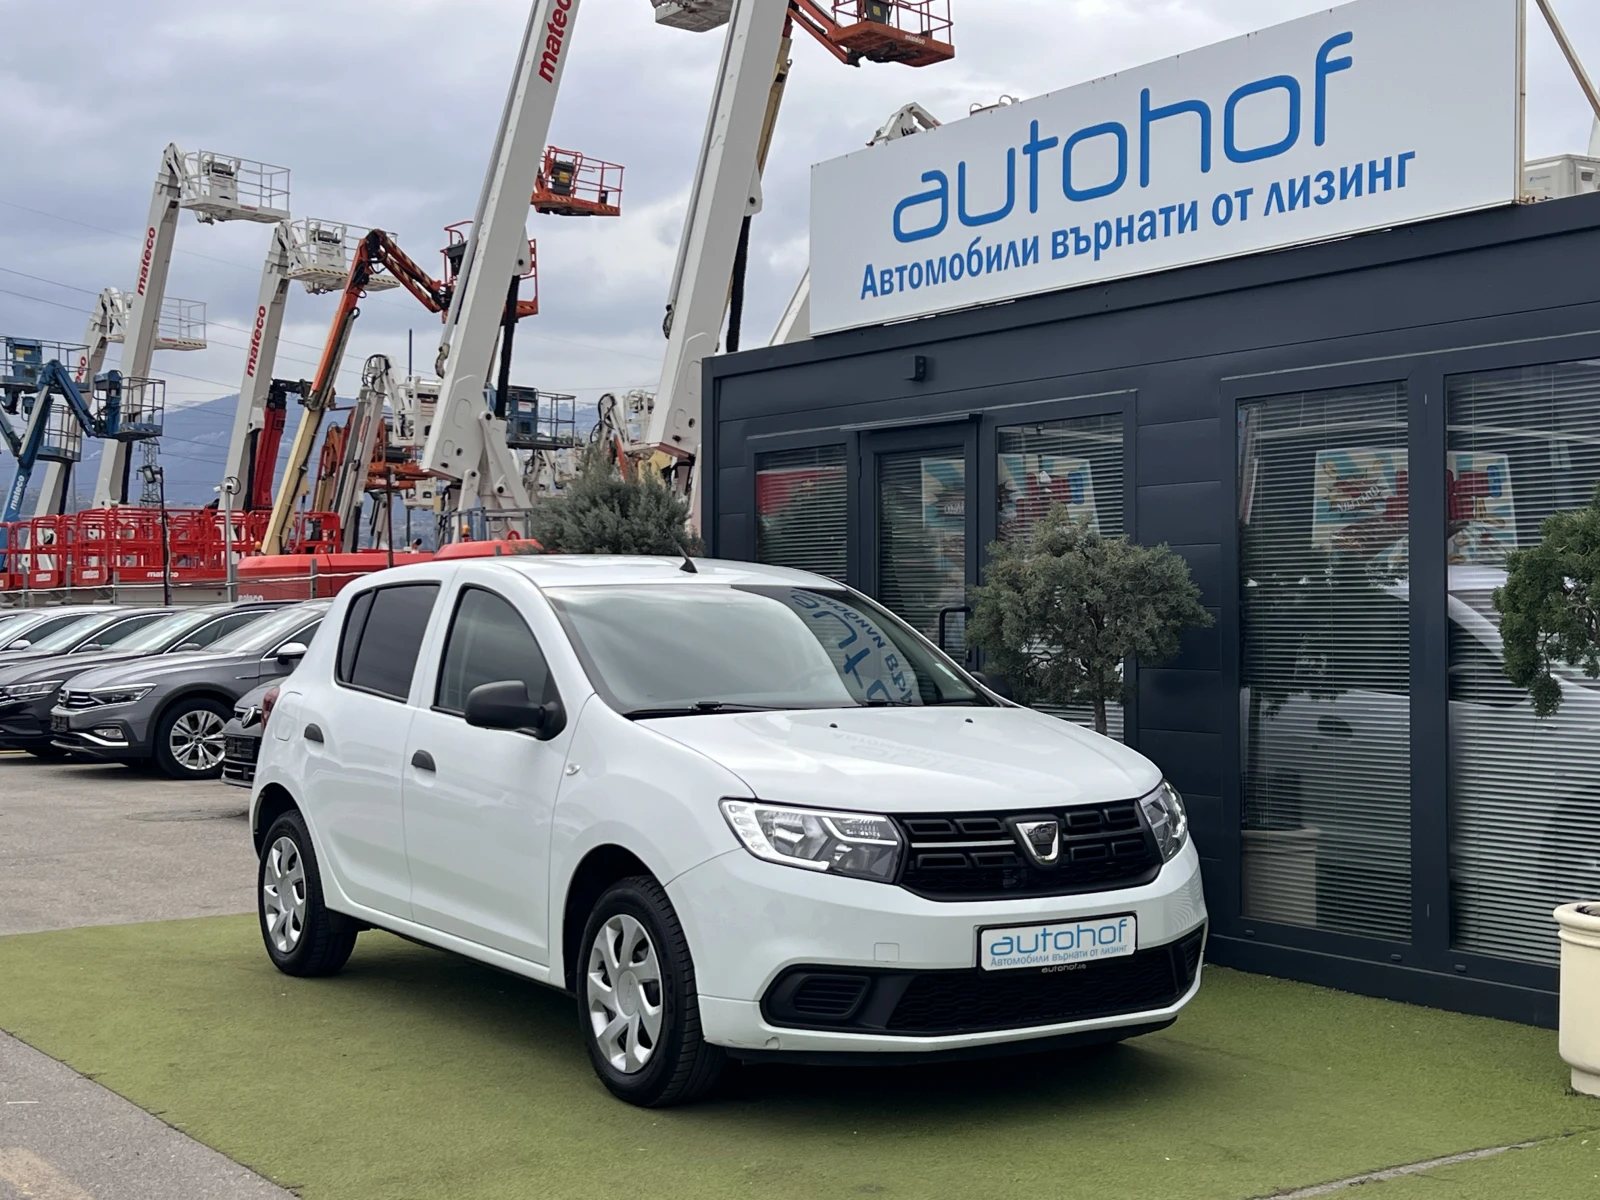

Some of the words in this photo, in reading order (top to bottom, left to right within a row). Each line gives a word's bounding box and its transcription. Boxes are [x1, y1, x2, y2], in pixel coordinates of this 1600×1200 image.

[538, 0, 572, 84] matec
[892, 31, 1353, 243] autohof
[861, 237, 1039, 298] Автомобили
[1051, 200, 1198, 261] върнати
[1211, 188, 1254, 226] от
[1263, 151, 1415, 216] лизинг
[137, 226, 156, 296] mateco
[247, 305, 266, 378] mateco
[10, 474, 25, 511] mateco
[990, 917, 1128, 957] autohof
[990, 954, 1049, 967] Автомобили
[1052, 951, 1088, 963] върнати
[1090, 949, 1099, 958] от
[1100, 945, 1128, 956] лизинг
